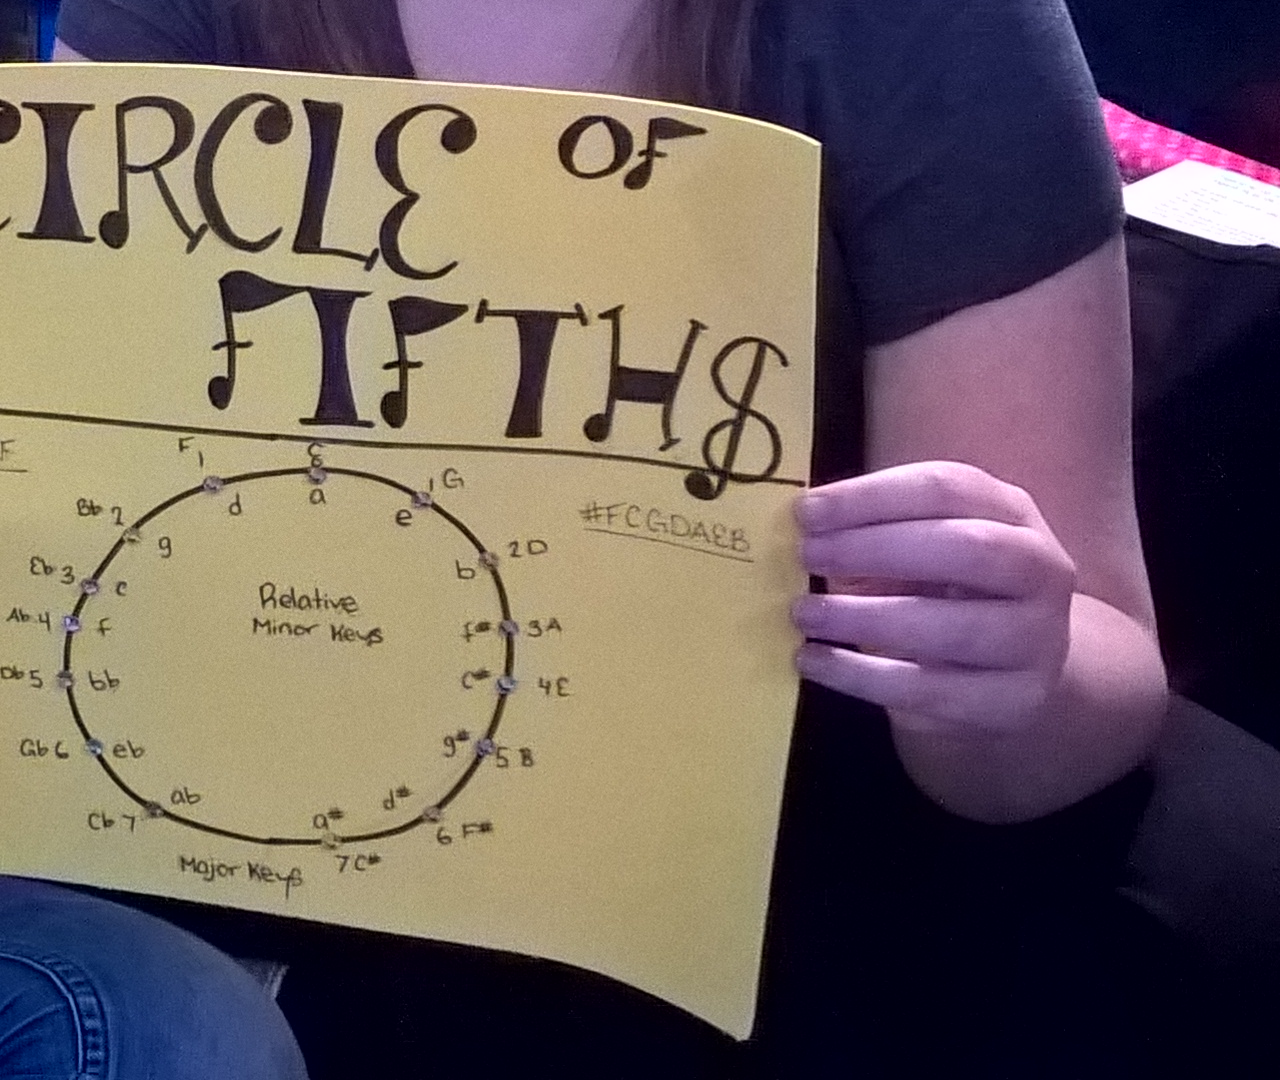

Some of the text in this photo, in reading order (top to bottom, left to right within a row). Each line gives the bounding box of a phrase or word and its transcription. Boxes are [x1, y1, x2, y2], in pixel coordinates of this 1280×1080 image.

[558, 115, 707, 190] OF
[208, 270, 790, 501] FIFTHS
[443, 469, 464, 489] G
[229, 492, 242, 516] d
[309, 488, 326, 505] a
[395, 508, 413, 527] e
[61, 566, 76, 585] 3
[456, 559, 476, 580] b
[259, 582, 359, 614] Relative
[253, 617, 384, 647] Minor Keys
[29, 669, 44, 689] 5
[55, 740, 70, 760] 6
[178, 856, 304, 899] Major Keys
